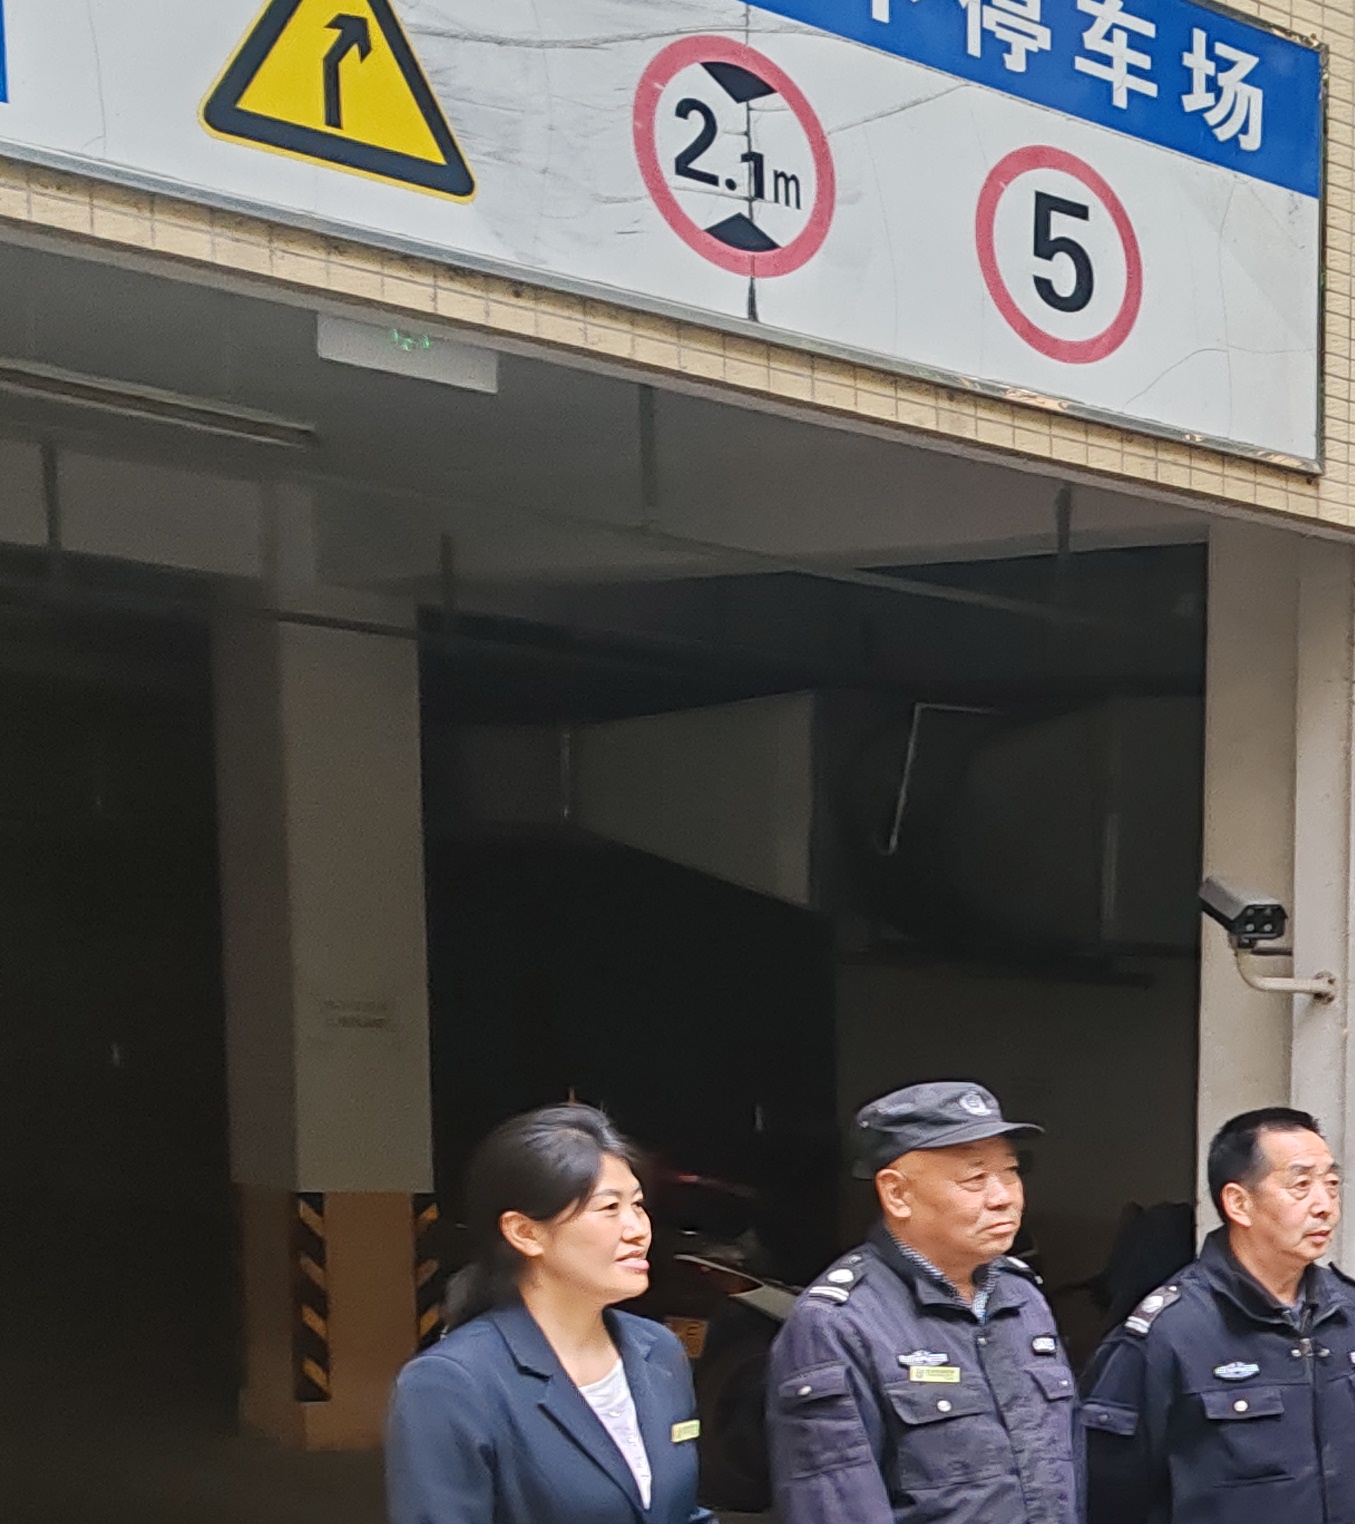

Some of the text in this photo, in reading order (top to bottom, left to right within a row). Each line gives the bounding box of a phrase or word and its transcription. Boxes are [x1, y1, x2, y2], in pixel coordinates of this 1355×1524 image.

[871, 0, 1263, 151] 停车场
[674, 97, 801, 210] 2.1m
[1033, 190, 1094, 313] 5
